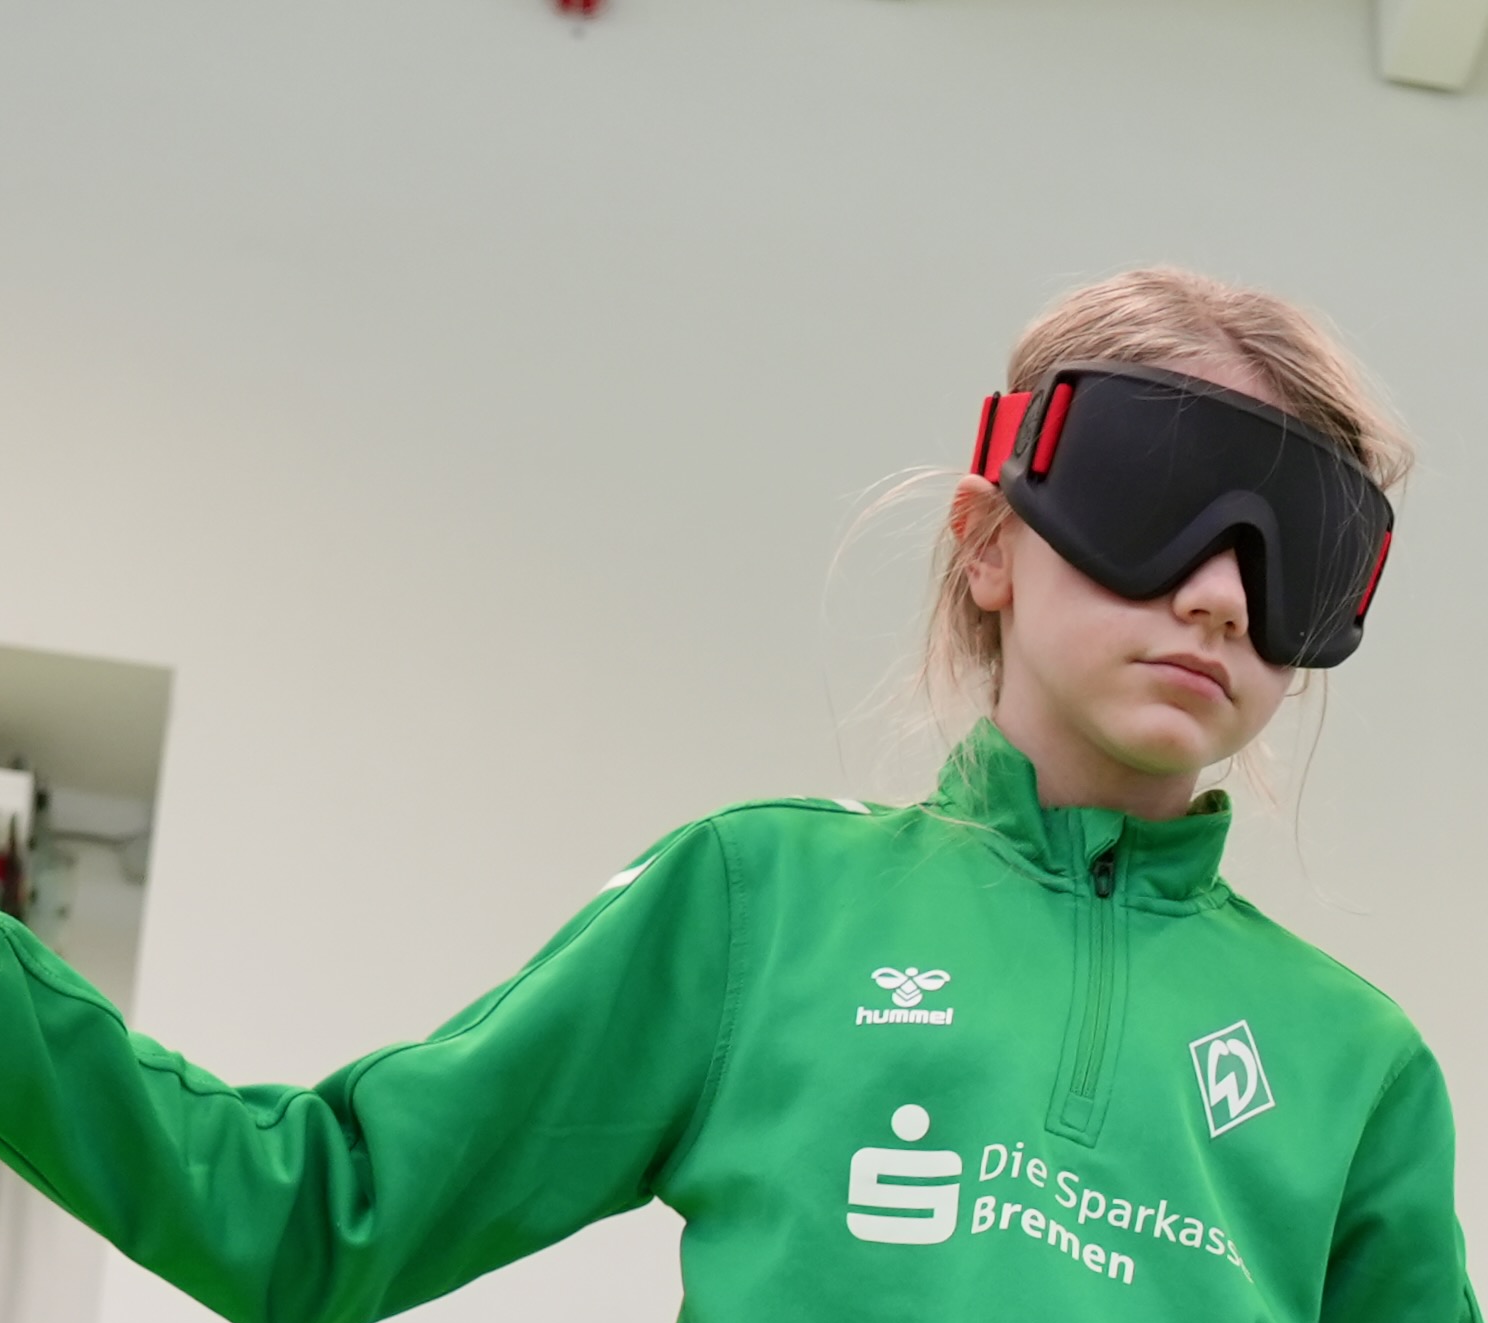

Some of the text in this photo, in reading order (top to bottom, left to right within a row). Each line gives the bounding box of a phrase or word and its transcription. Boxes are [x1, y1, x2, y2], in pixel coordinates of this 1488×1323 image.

[855, 1006, 954, 1025] hummel
[978, 1141, 1048, 1188] Die
[970, 1195, 1135, 1285] Bremen
